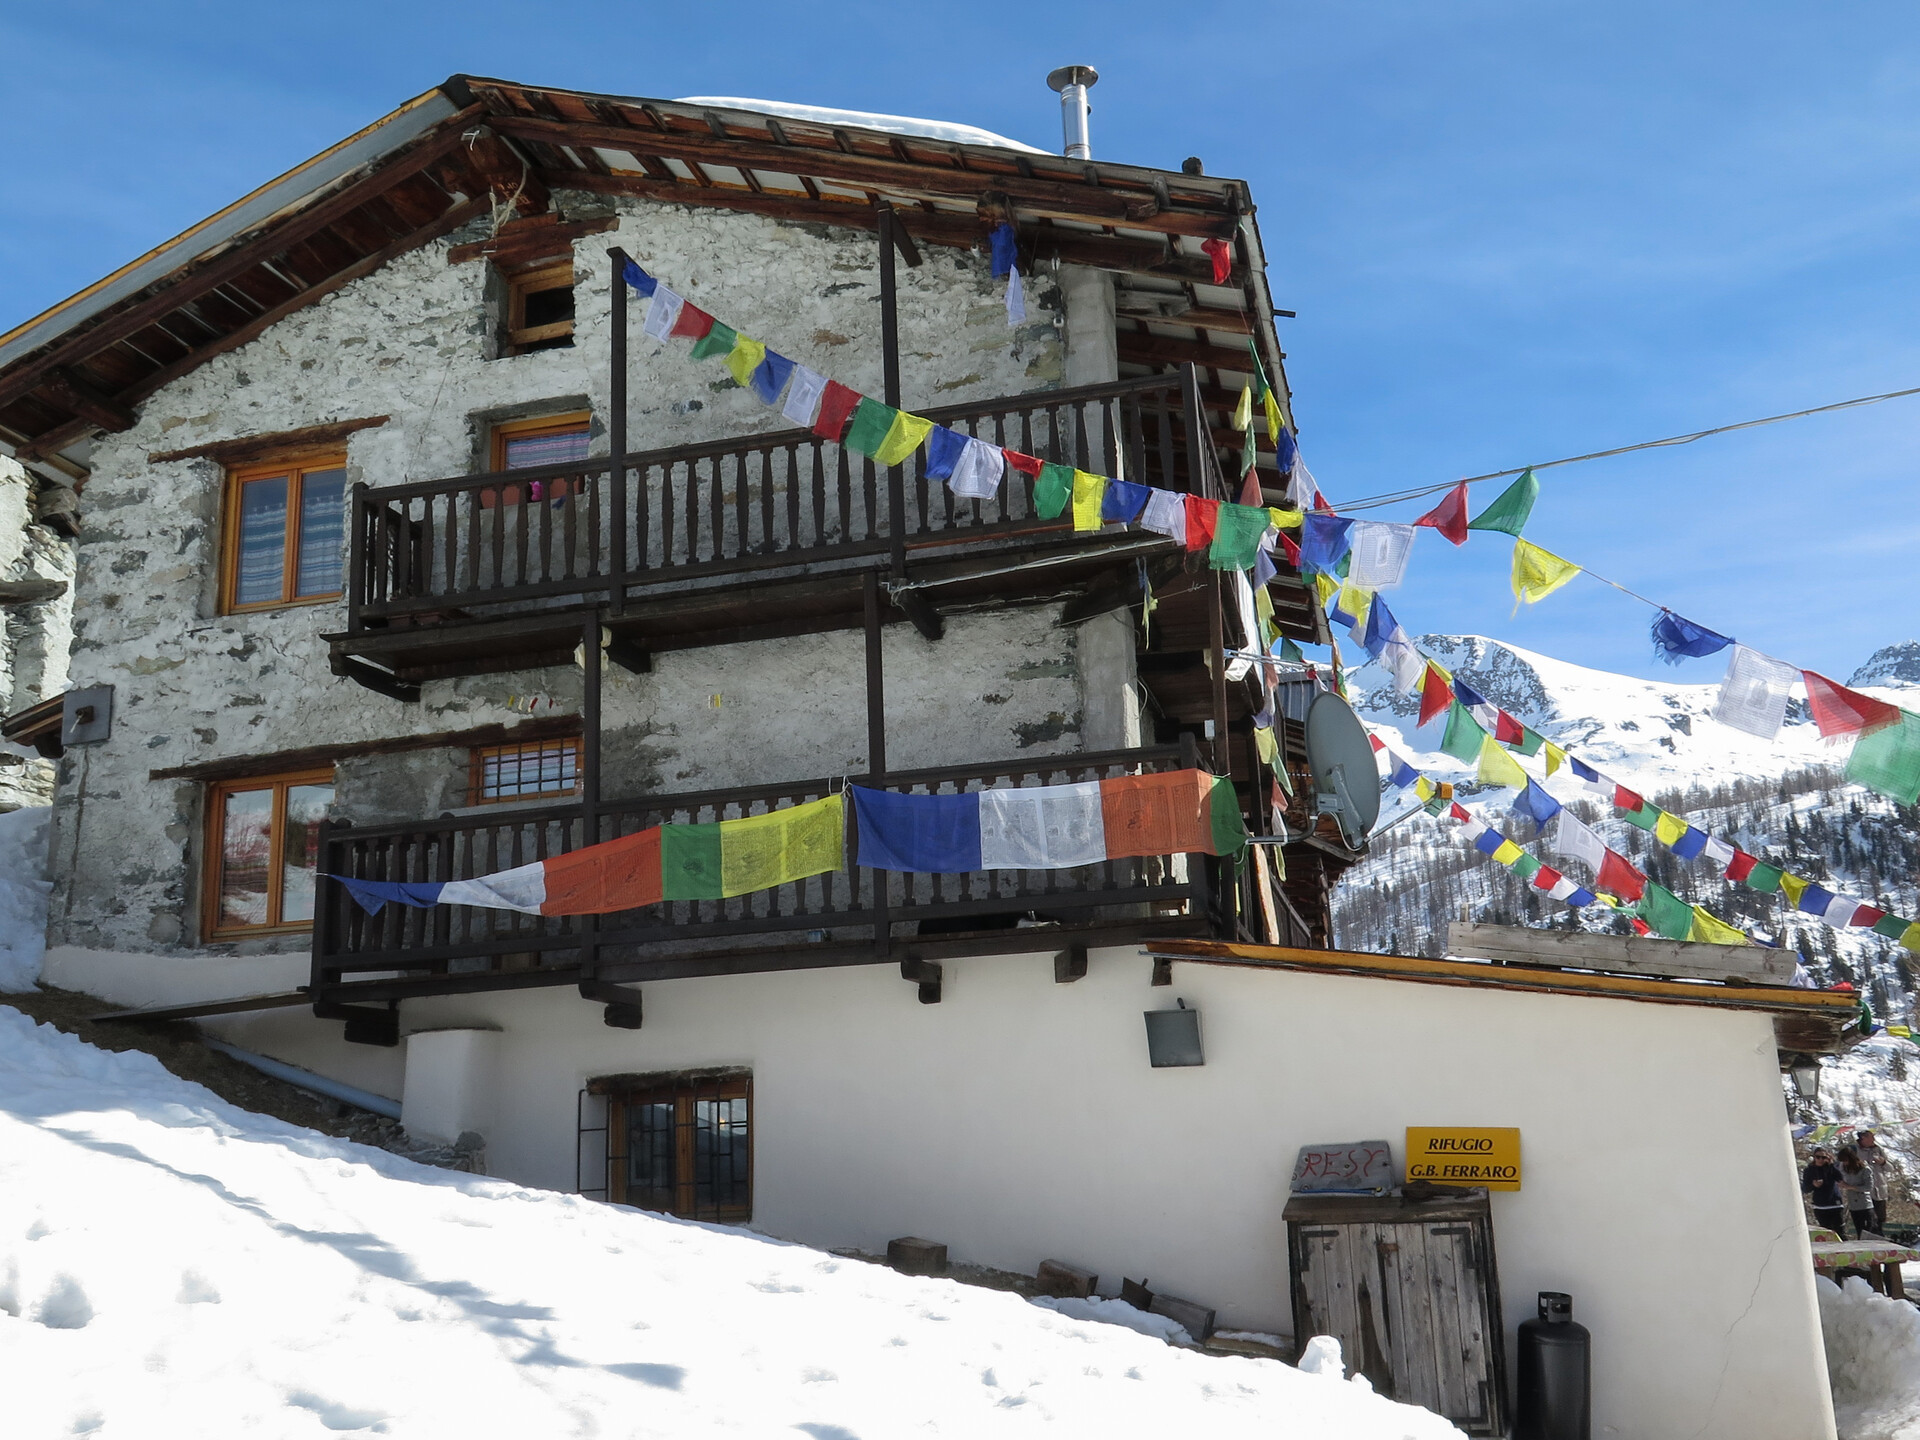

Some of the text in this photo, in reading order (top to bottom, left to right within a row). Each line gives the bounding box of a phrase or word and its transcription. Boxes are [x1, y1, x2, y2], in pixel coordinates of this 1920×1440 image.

[1428, 1138, 1493, 1151] RIFUGIO
[1301, 1149, 1384, 1177] RESY
[1410, 1164, 1517, 1178] G.B. FERRARO
